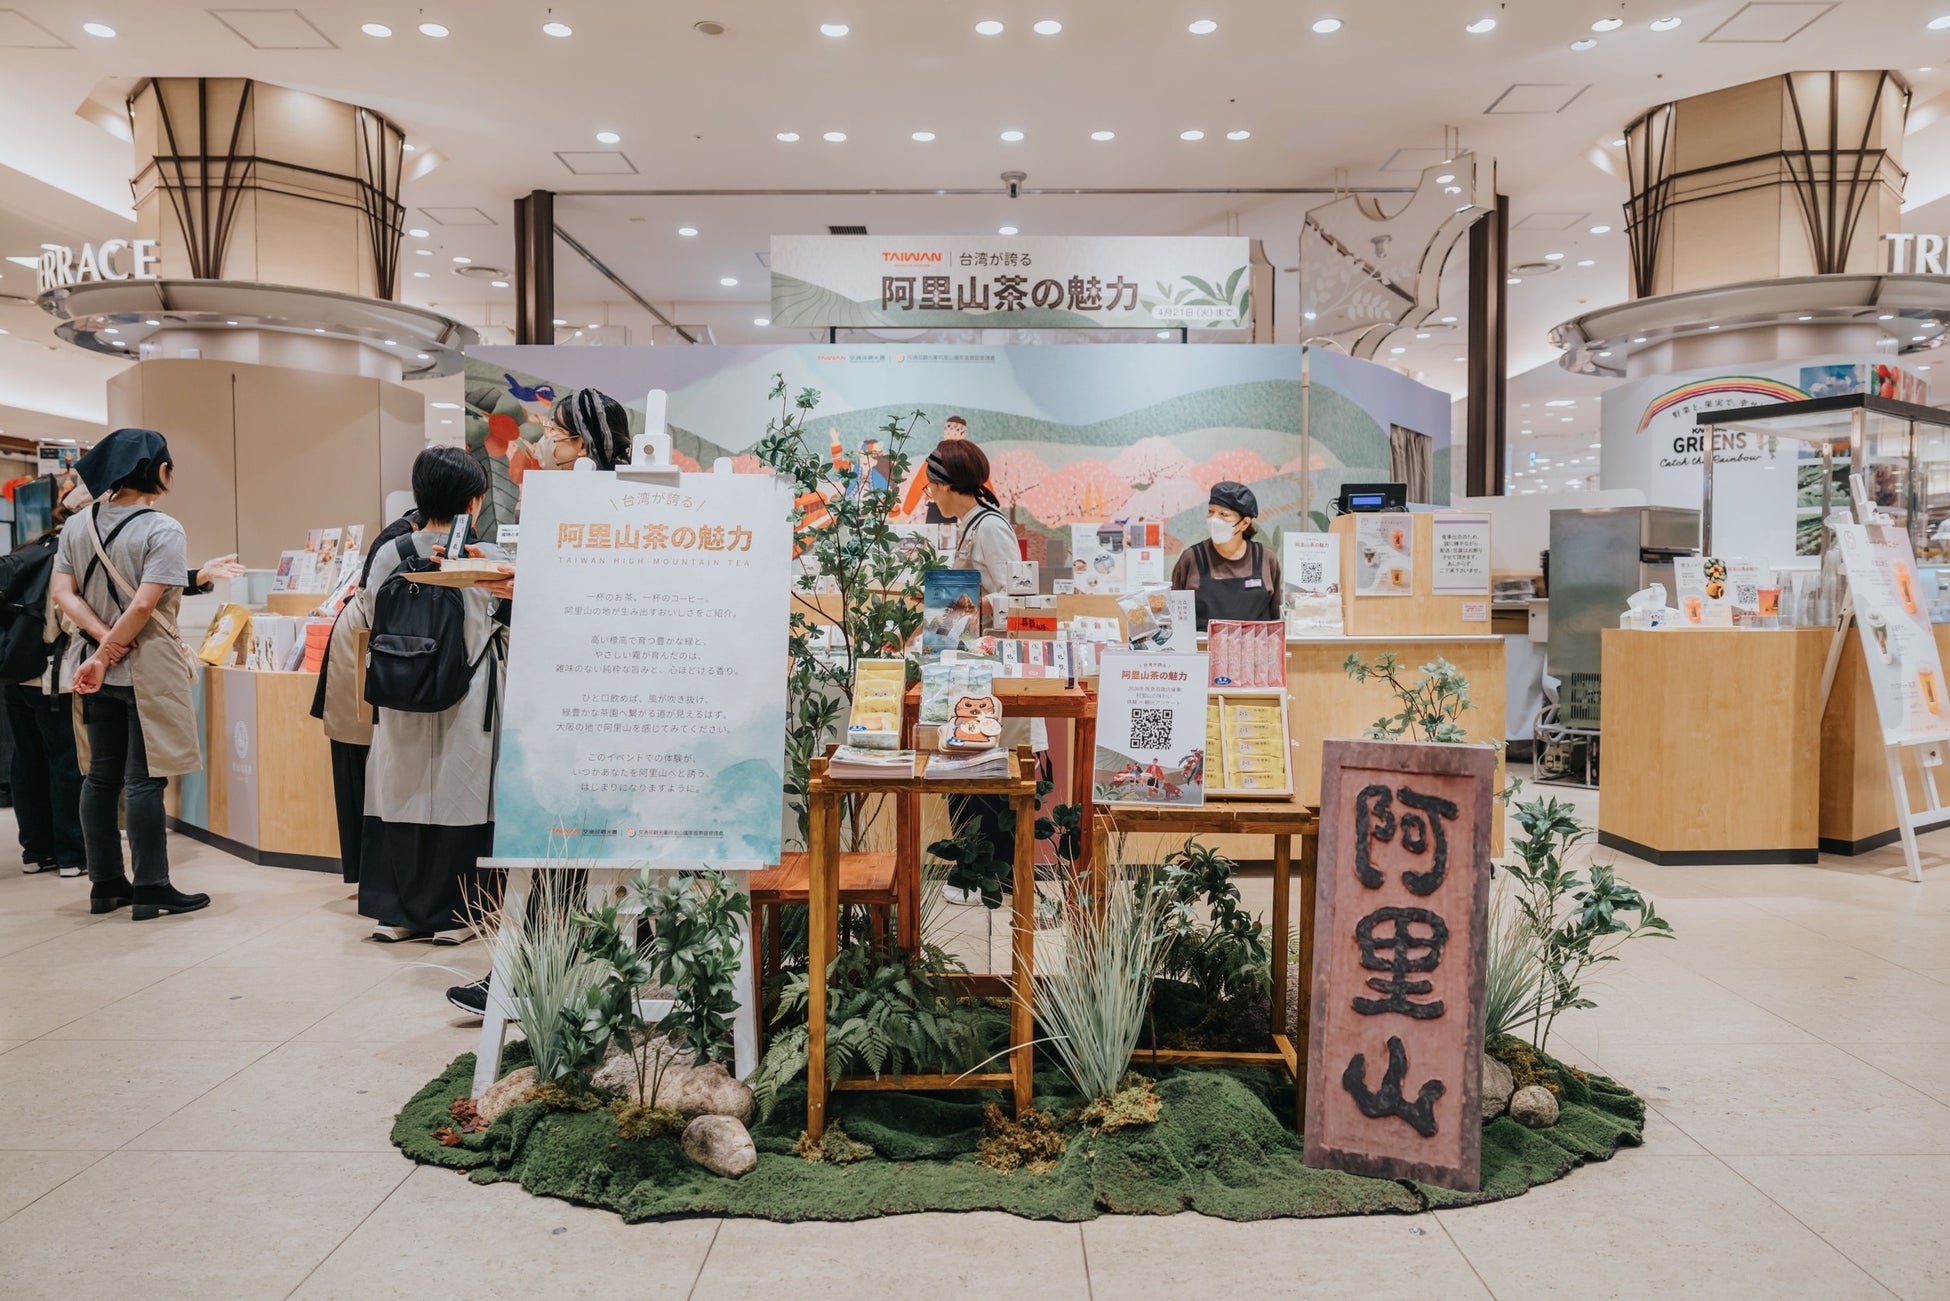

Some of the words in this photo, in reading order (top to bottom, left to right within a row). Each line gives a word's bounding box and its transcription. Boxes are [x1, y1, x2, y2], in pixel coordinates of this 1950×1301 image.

[882, 252, 942, 262] TAIWAN
[959, 252, 1032, 267] 台湾が誇る
[881, 275, 1138, 311] 阿里山茶の魅力
[621, 492, 694, 509] 台湾が誇る
[557, 522, 753, 552] 阿里山茶の魅力
[652, 558, 721, 567] MOUNTAIN
[728, 559, 751, 567] TEA
[586, 592, 710, 603] 一杯のお茶、一杯のコーヒー。
[563, 606, 737, 619] 阿里山の地が生み出すおいしさをご紹介。
[555, 664, 739, 676] 雑味のない純粋な旨みと、心ほどける香り。
[1121, 670, 1188, 681] 阿里山茶の魅力
[555, 722, 732, 735] 大阪の地で阿里山を感じてみてください。
[587, 753, 697, 764] このイベントでの体験が、
[572, 768, 711, 778] いつかあなたを阿里山へと誘う、
[580, 783, 700, 794] はじまりになりますように。
[1342, 785, 1460, 1138] 阿里山
